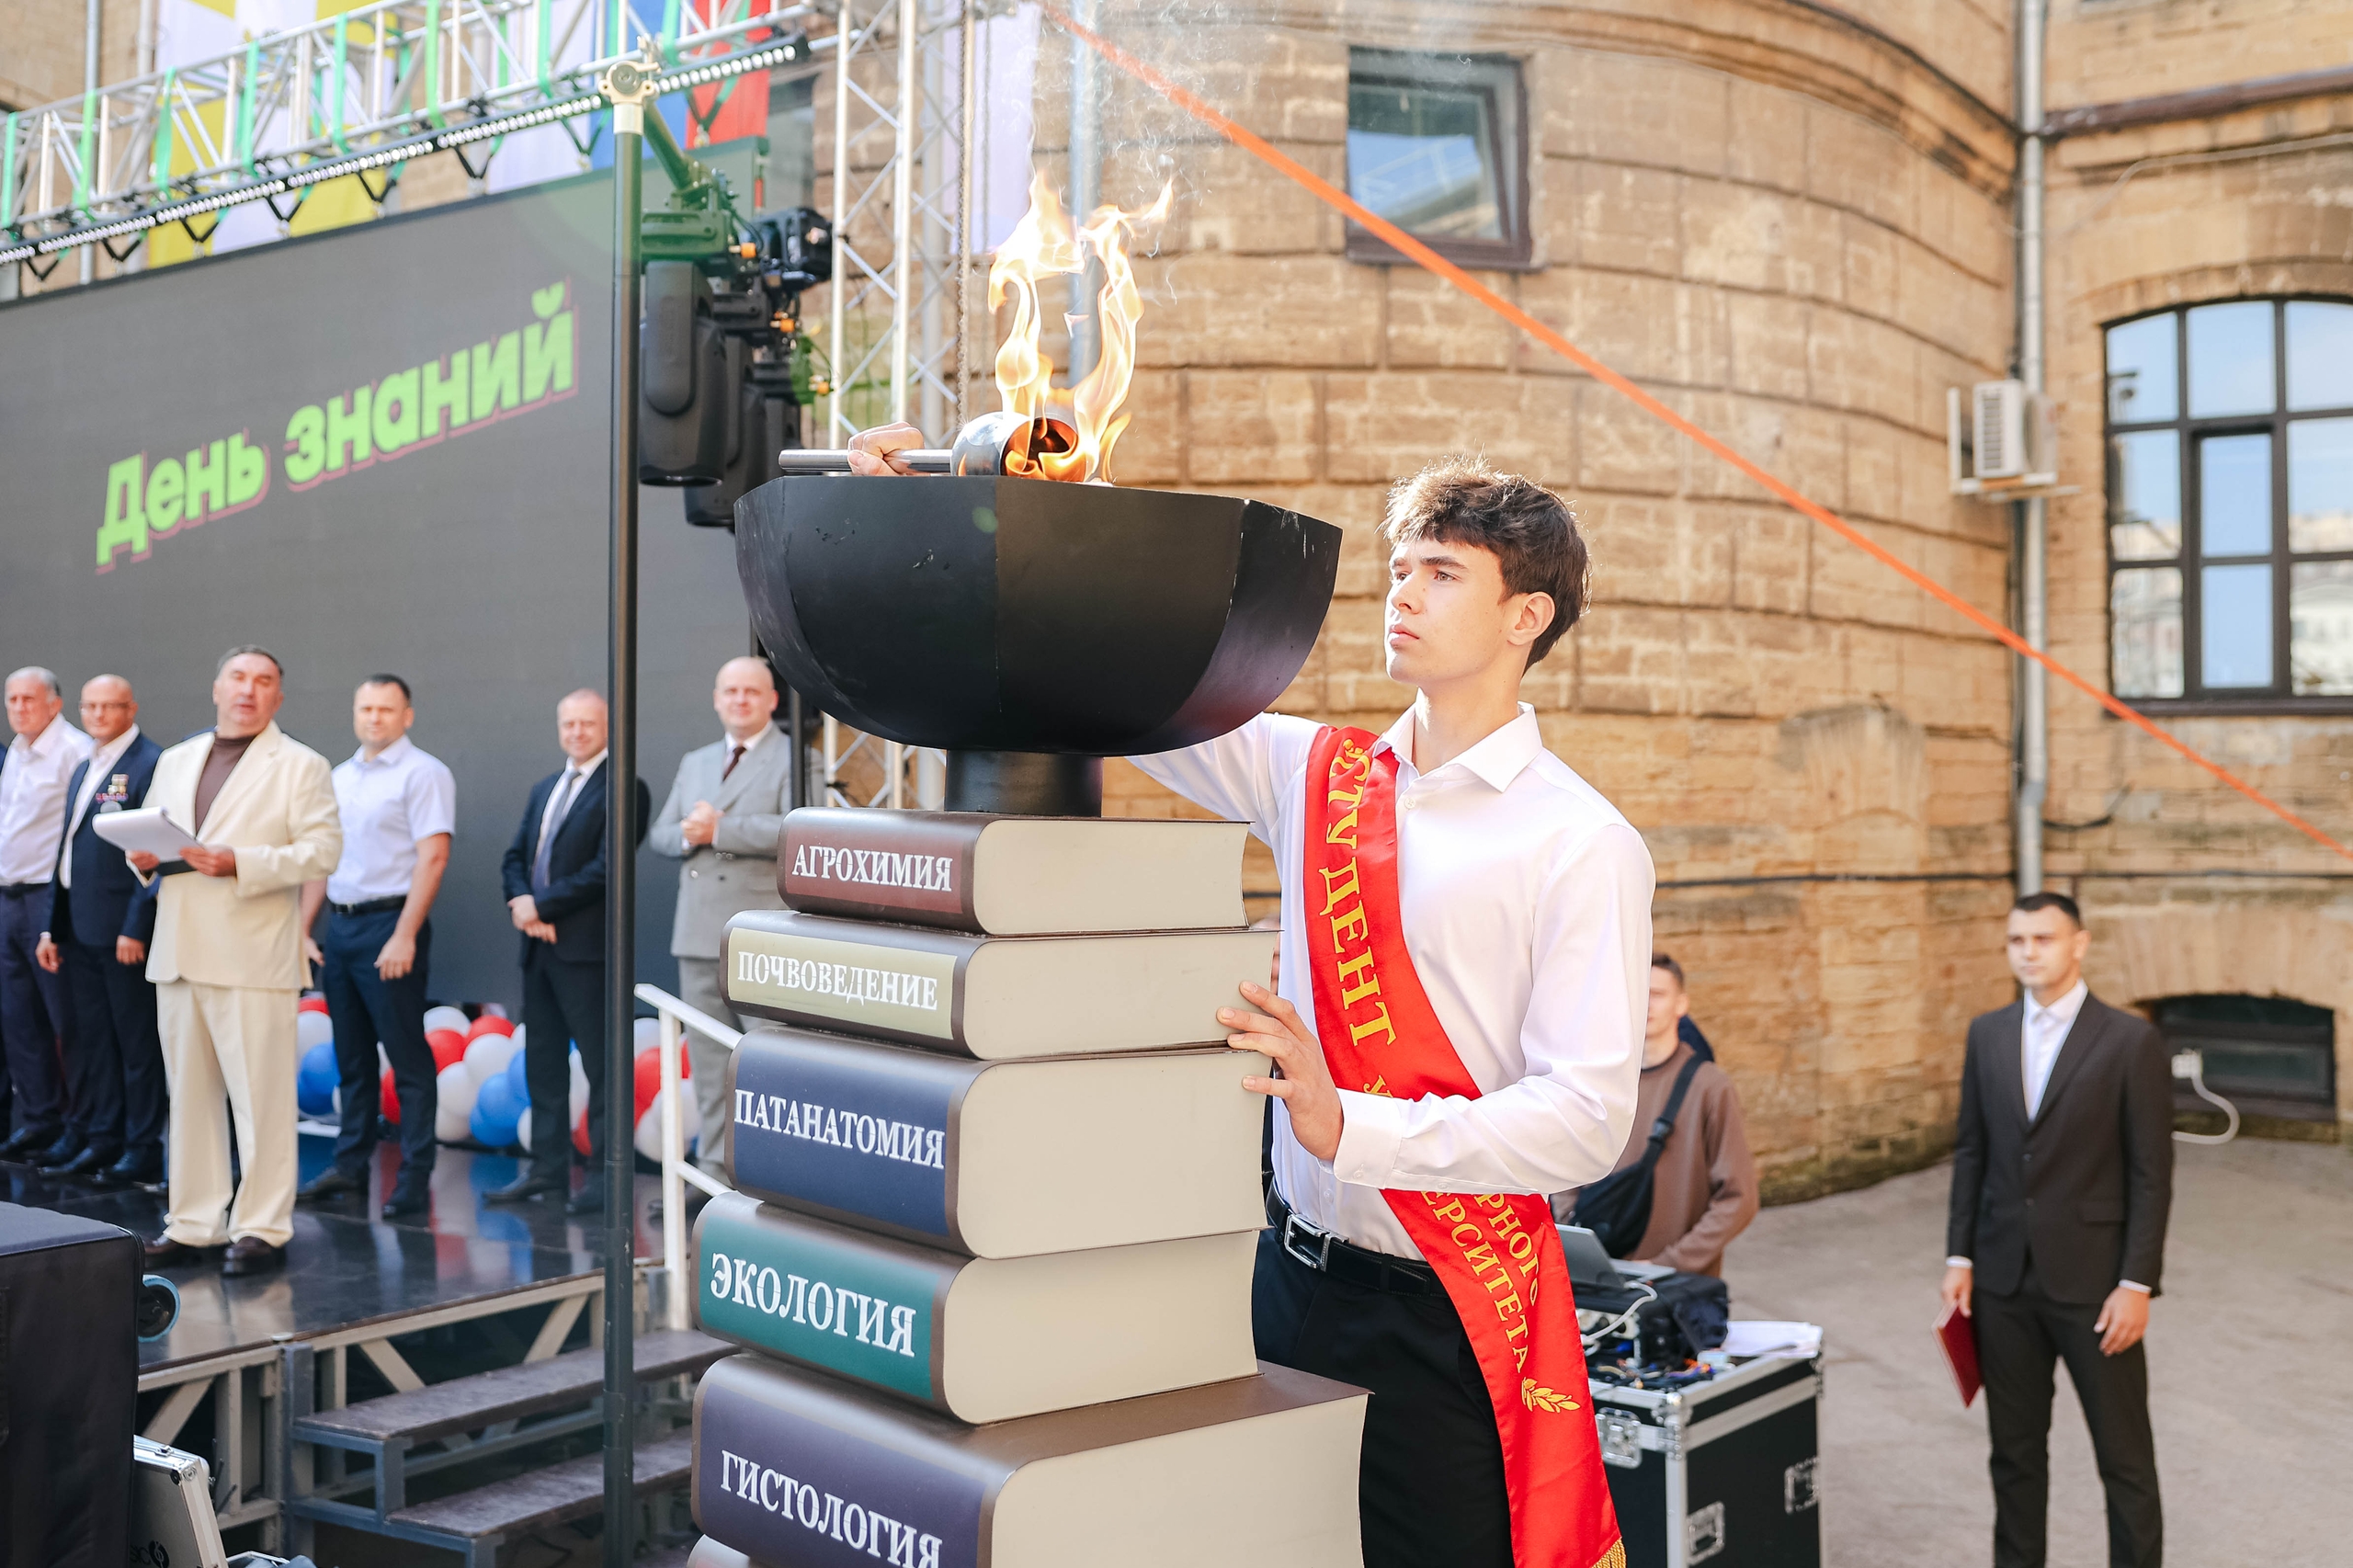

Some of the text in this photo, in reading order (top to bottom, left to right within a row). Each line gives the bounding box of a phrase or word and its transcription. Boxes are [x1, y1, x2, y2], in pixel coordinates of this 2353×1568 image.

[97, 280, 576, 572] День знаний
[791, 844, 953, 892] АГРОХИМИЯ
[1319, 754, 1397, 1046] СТУДЕНТ
[737, 950, 938, 1011] ПОЧВОВЕДЕНИЕ
[734, 1088, 945, 1169] ПАТАНАТОМИЯ
[710, 1252, 916, 1358] ЭКОЛОГИЯ
[721, 1449, 943, 1568] ГИСТОЛОГИЯ
